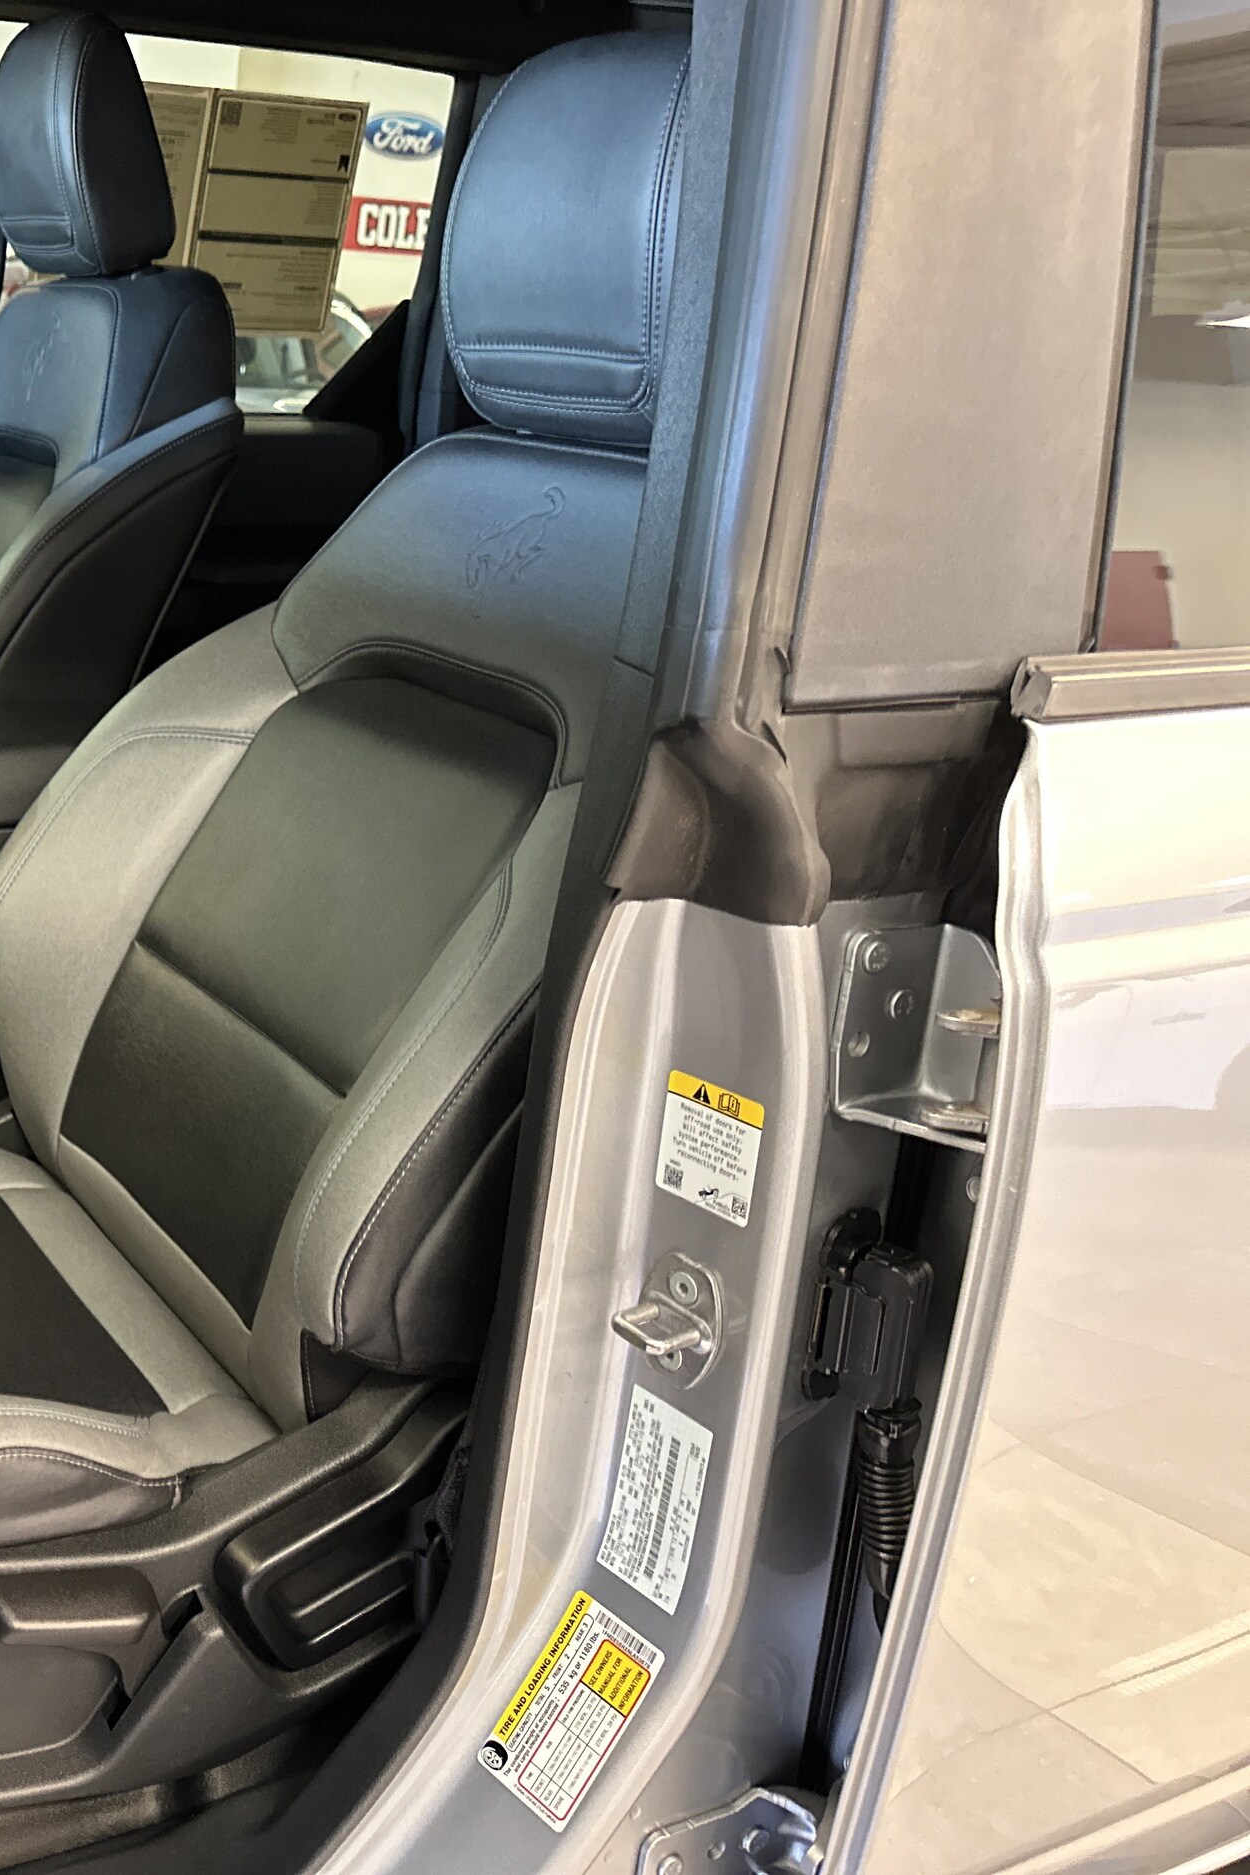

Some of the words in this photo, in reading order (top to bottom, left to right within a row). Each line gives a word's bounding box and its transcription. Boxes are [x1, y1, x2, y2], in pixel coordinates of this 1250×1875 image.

[373, 118, 436, 154] Ford
[681, 1102, 704, 1118] Removal
[715, 1118, 733, 1131] doors
[735, 1126, 746, 1136] for
[684, 1115, 711, 1131] off-road
[713, 1128, 724, 1137] use
[679, 1131, 699, 1144] system
[683, 1123, 696, 1134] Will
[699, 1131, 719, 1144] affect
[722, 1140, 742, 1156] safety
[673, 1136, 687, 1148] Turn
[689, 1146, 712, 1160] vehicle
[713, 1156, 725, 1164] off
[726, 1161, 748, 1176] before
[677, 1149, 717, 1173] reconnecting
[499, 1715, 515, 1736] TIRE
[513, 1696, 527, 1716] AND
[525, 1658, 552, 1696] LOADING
[549, 1598, 586, 1658] INFORMATION
[558, 1680, 570, 1695] 535
[568, 1670, 578, 1680] kg
[575, 1661, 582, 1670] or
[579, 1643, 593, 1661] 1180
[589, 1633, 600, 1644] lbs.
[588, 1675, 599, 1687] SEE
[595, 1650, 613, 1676] OWNERS
[598, 1671, 616, 1695] MANUAL
[612, 1657, 623, 1671] FOR
[609, 1667, 632, 1701] ADDITIONAL
[618, 1671, 644, 1710] INFORMATION
[503, 1767, 512, 1777] The
[510, 1744, 526, 1768] combined
[525, 1729, 536, 1745] weight
[538, 1699, 555, 1723] occupants
[509, 1732, 521, 1748] SEATING
[519, 1712, 533, 1733] CAPACITY
[514, 1763, 522, 1773] and
[520, 1749, 531, 1764] cargo
[529, 1733, 541, 1750] should
[539, 1720, 549, 1734] never
[547, 1703, 559, 1720] exceed
